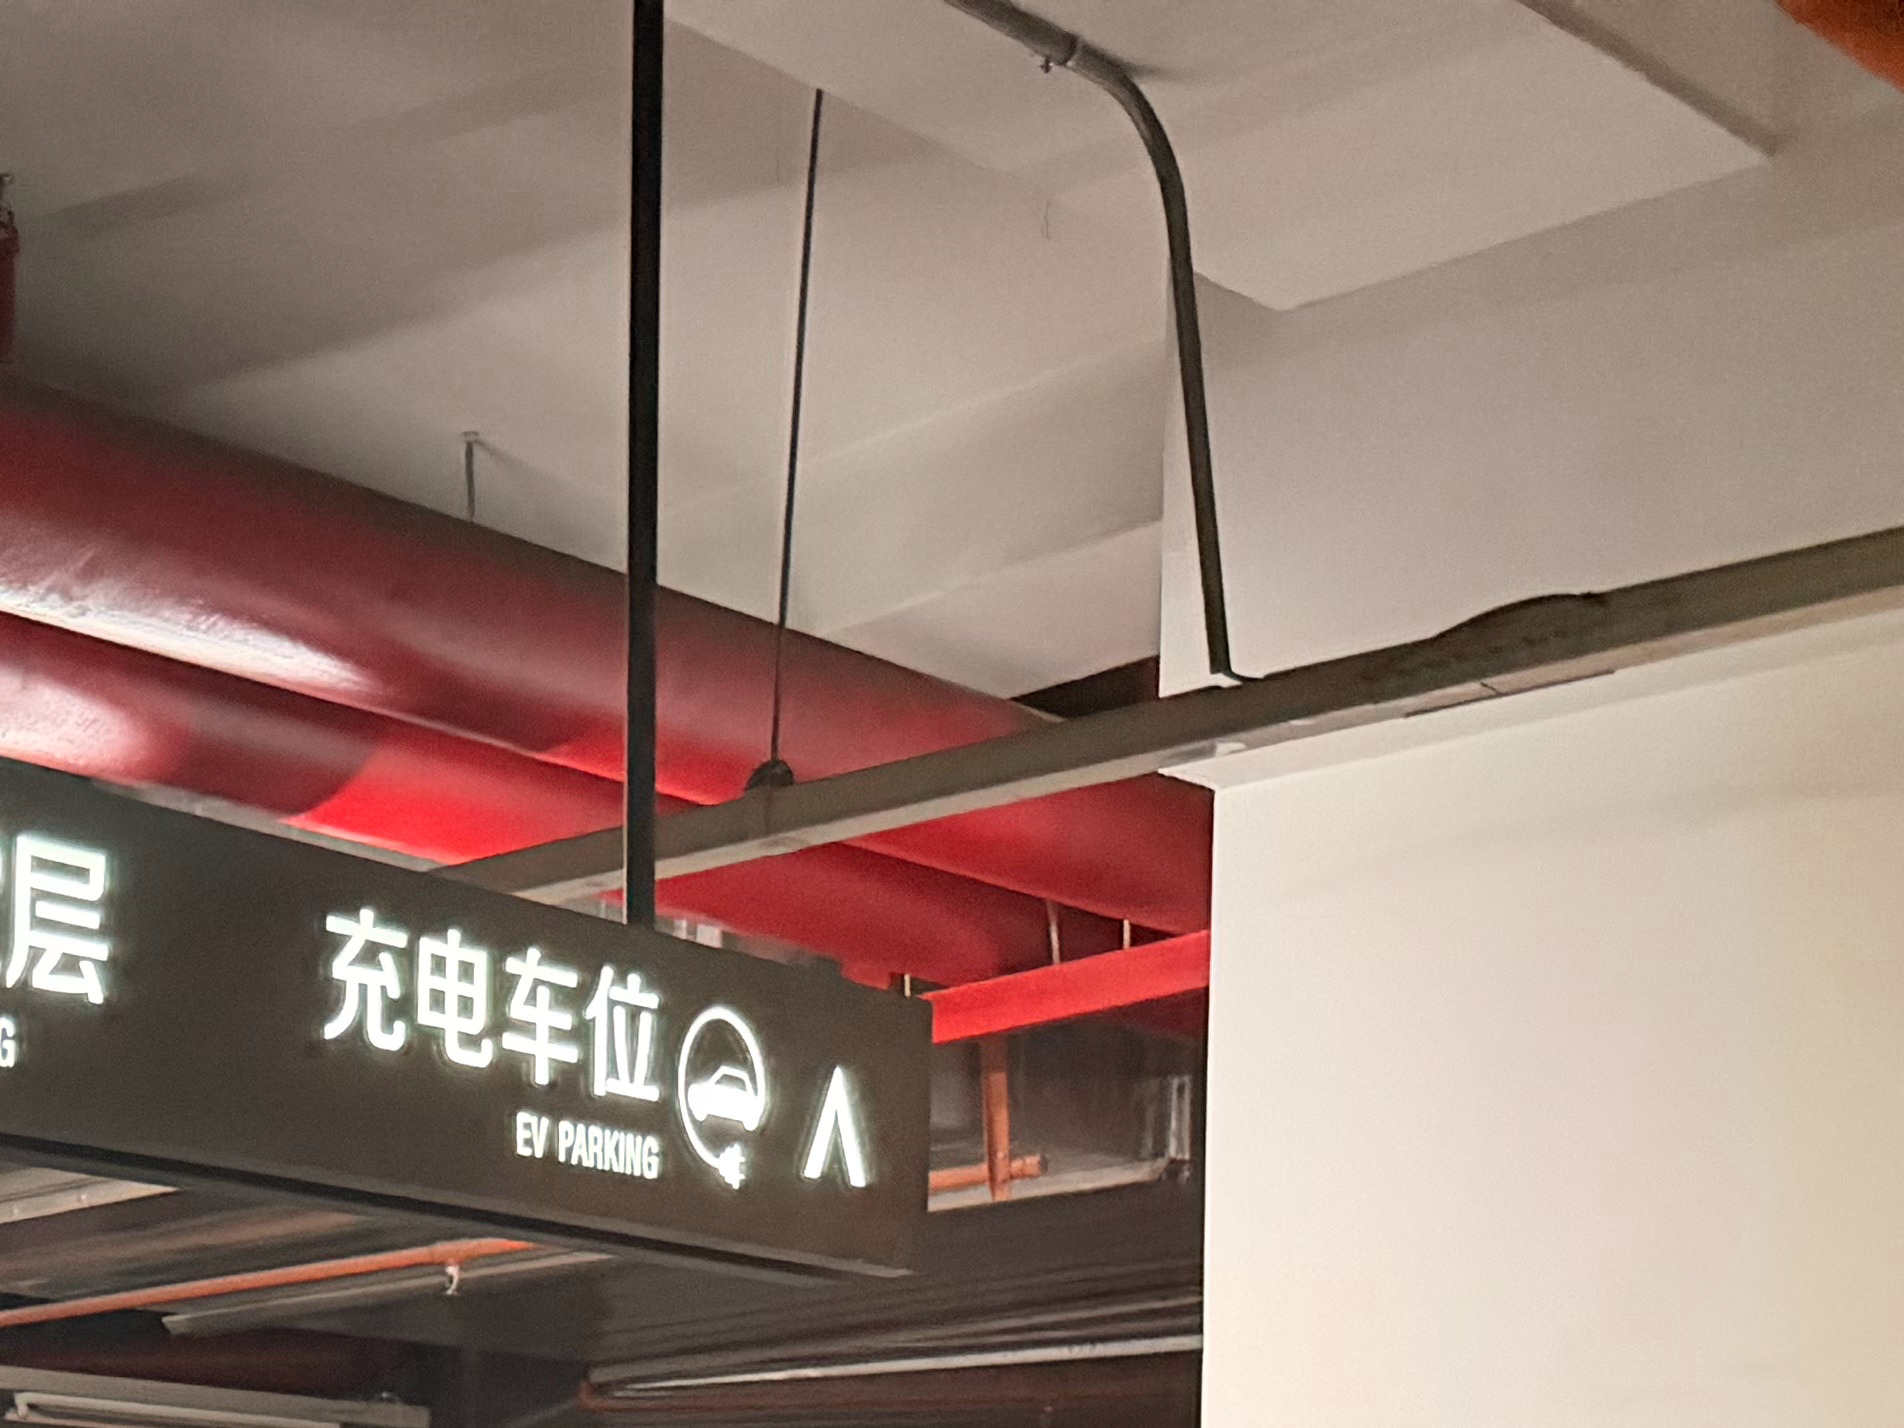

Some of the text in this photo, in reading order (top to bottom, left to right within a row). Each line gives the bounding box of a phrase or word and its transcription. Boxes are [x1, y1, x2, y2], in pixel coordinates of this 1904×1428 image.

[323, 908, 660, 1102] 充电车位
[515, 1111, 660, 1180] EV PARKING
